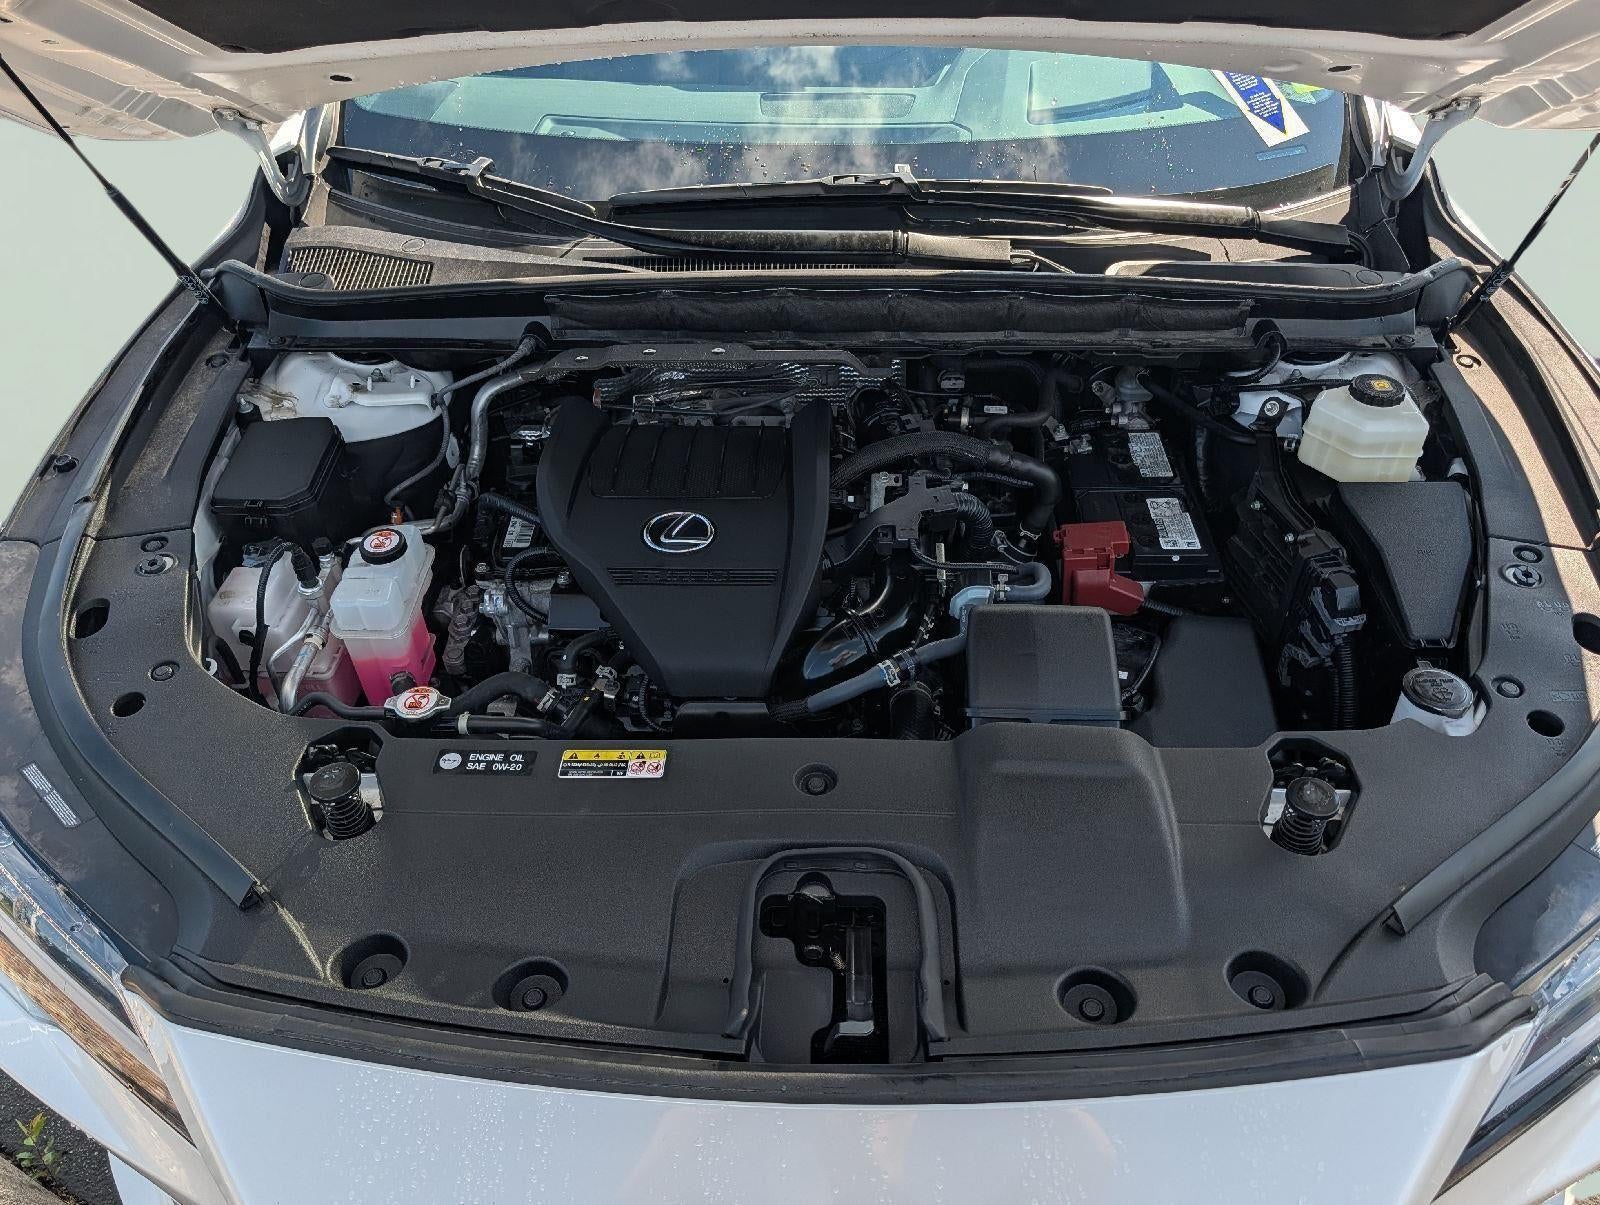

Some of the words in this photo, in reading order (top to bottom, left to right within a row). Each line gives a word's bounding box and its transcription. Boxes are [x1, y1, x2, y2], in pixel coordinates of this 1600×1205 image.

[469, 753, 504, 761] ENGINE
[509, 754, 525, 762] OIL
[466, 762, 487, 770] SAE
[492, 762, 523, 771] 0W-20
